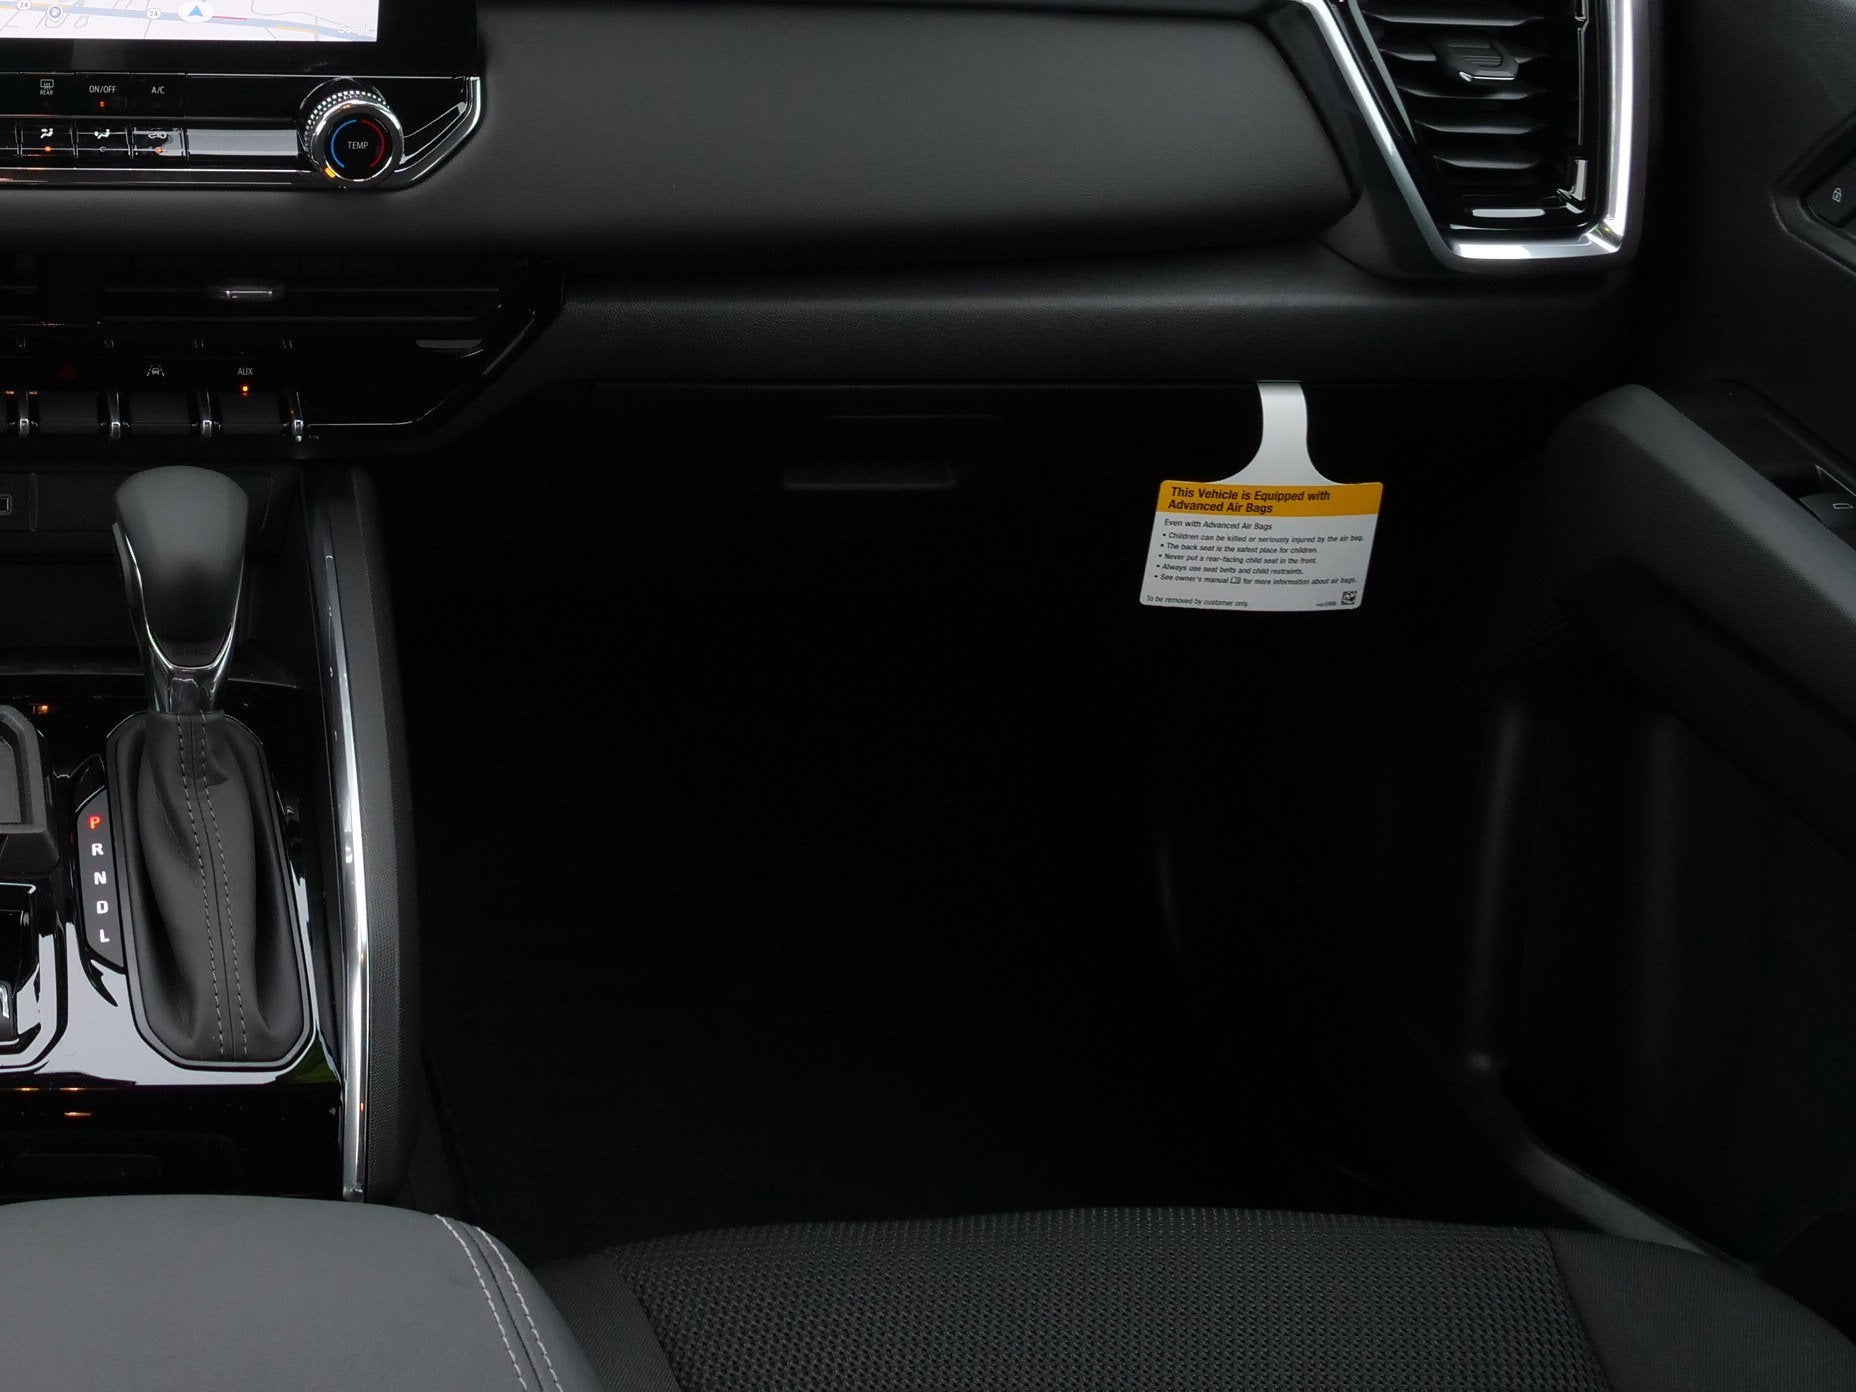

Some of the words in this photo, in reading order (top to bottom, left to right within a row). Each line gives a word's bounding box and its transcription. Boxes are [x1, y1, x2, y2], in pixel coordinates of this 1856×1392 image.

[148, 10, 158, 18] 24
[88, 85, 116, 93] ON/OFF
[151, 85, 165, 94] A/C
[347, 141, 369, 150] TEMP
[237, 366, 254, 376] AUX
[1171, 487, 1195, 498] This
[1198, 488, 1238, 500] Vehicle
[1241, 490, 1251, 500] is
[1254, 490, 1305, 504] Equipped
[1307, 490, 1331, 501] with
[1168, 500, 1224, 512] Advanced
[1226, 502, 1243, 512] Air
[1245, 503, 1273, 515] Bags
[1164, 519, 1183, 527] Even
[1203, 521, 1240, 529] Advanced
[1241, 522, 1252, 530] Air
[1253, 522, 1273, 531] Bags
[1168, 531, 1199, 540] Children
[1258, 536, 1290, 544] seriously
[1291, 536, 1315, 544] injured
[1317, 536, 1326, 544] by
[1350, 534, 1364, 543] bag.
[1205, 556, 1244, 564] rear-facing
[1162, 563, 1188, 572] Always
[1234, 599, 1249, 607] only.
[89, 816, 100, 829] P
[91, 843, 104, 856] R
[94, 870, 107, 885] N
[96, 900, 109, 915] D
[99, 928, 111, 943] L
